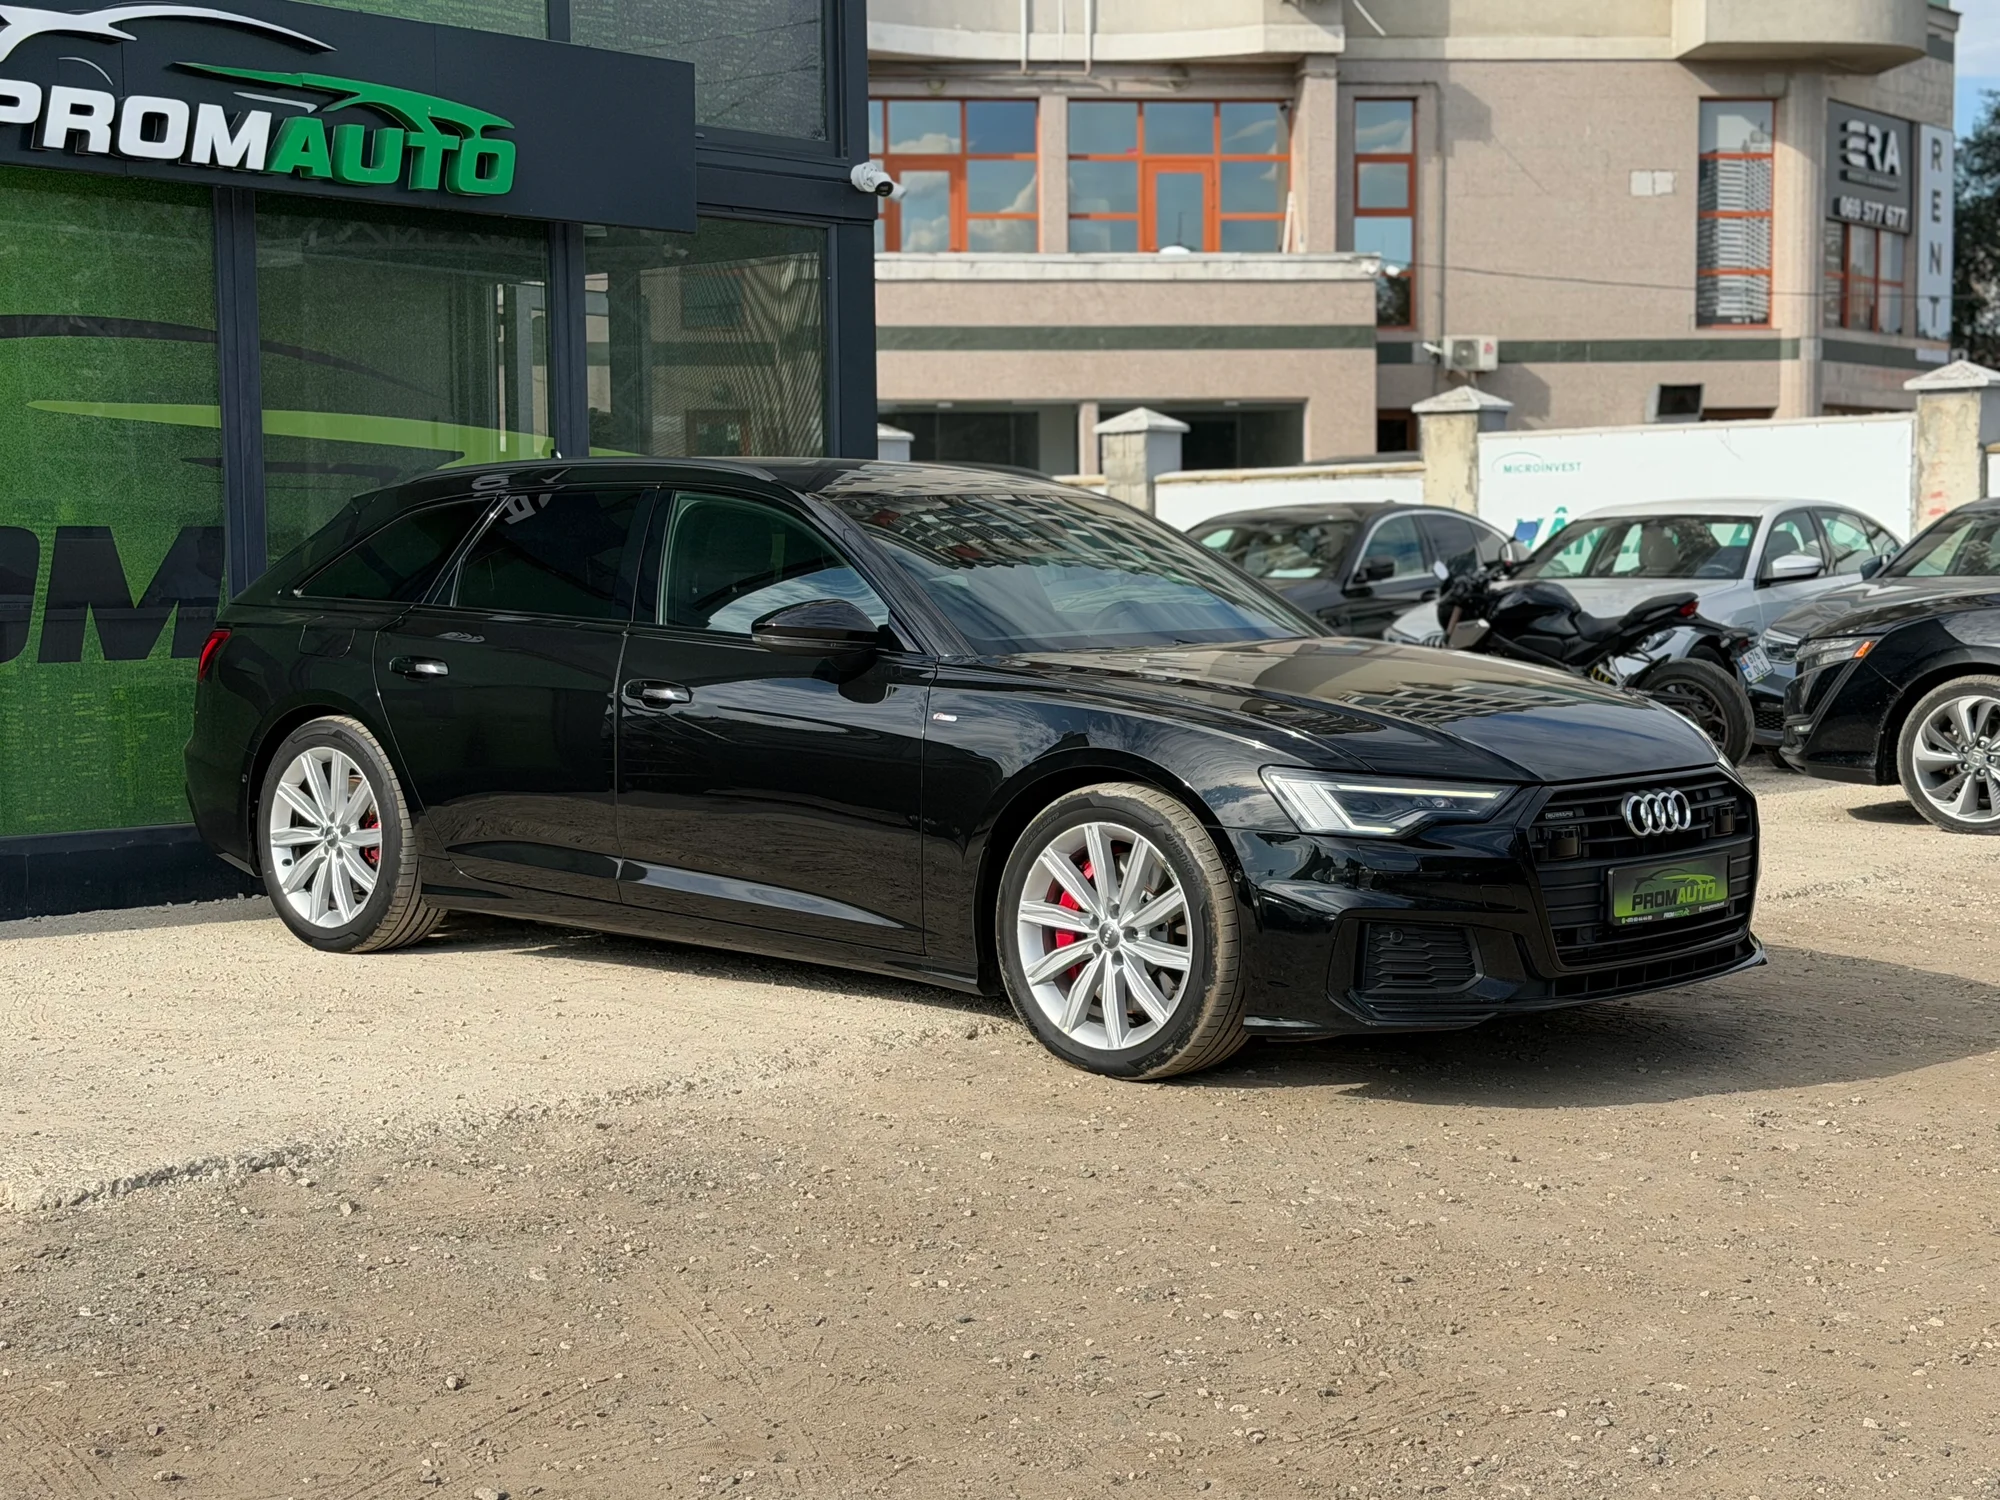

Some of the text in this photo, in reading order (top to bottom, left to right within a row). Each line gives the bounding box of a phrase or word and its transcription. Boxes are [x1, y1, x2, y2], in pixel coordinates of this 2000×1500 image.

[1845, 119, 1902, 176] ERA
[1863, 200, 1885, 224] 577
[1928, 137, 1943, 328] RENT
[1503, 461, 1582, 474] MICROINVEST
[1632, 882, 1716, 911] PROMAUTO
